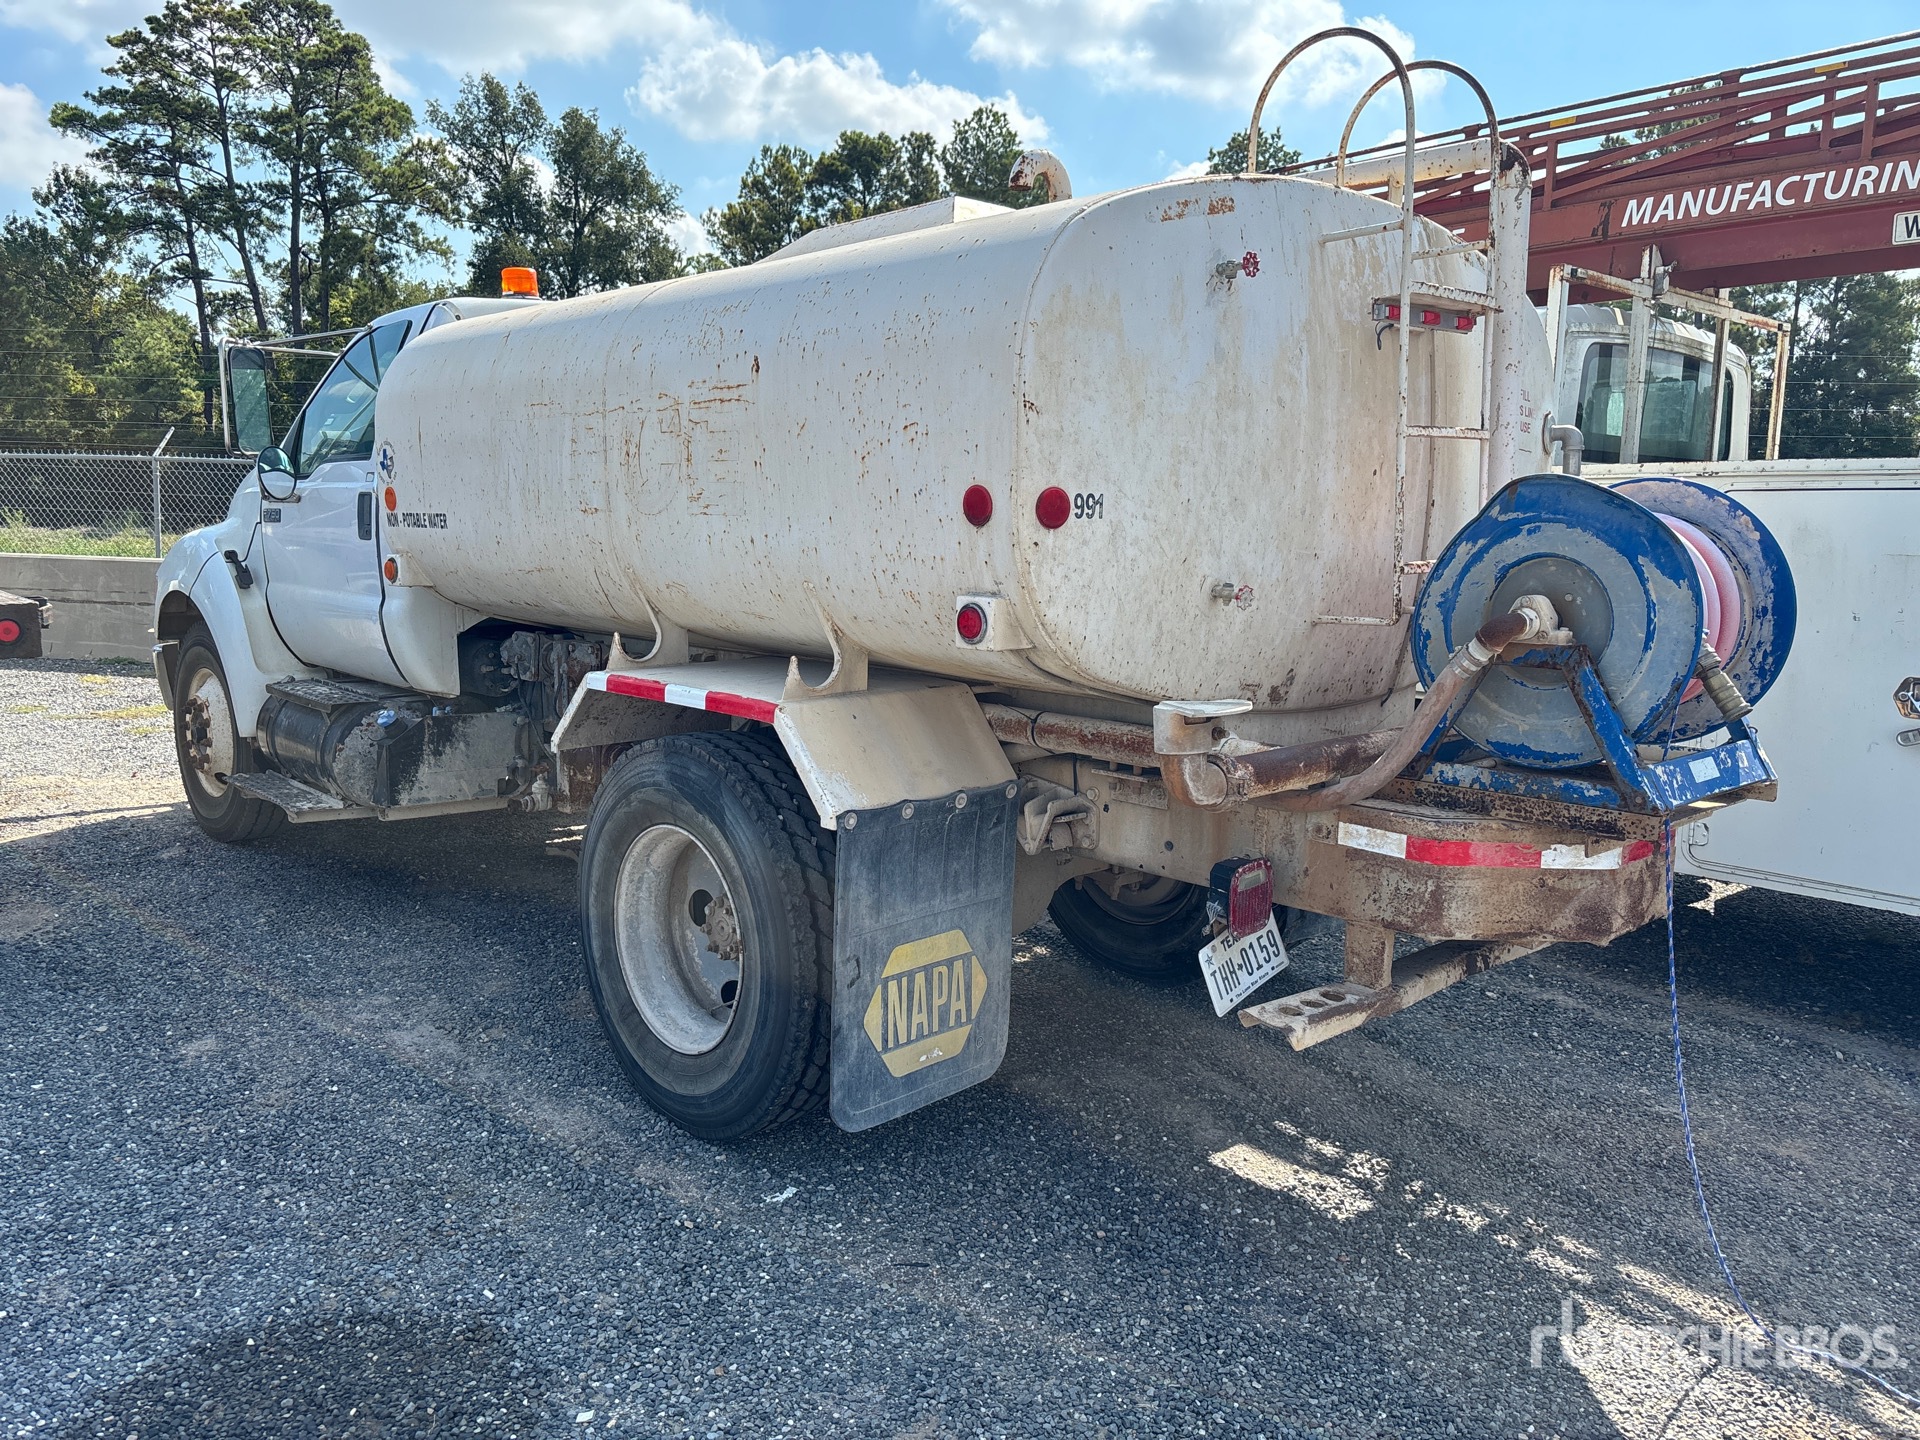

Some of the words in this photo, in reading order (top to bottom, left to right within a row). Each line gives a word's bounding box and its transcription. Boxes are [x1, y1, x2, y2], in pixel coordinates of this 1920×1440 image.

[1524, 406, 1535, 419] LIN
[1519, 421, 1531, 434] USE
[1073, 492, 1104, 520] 991
[386, 512, 400, 528] NON
[402, 512, 428, 529] POTABLE
[427, 512, 449, 530] WATER
[887, 959, 967, 1049] NAPA
